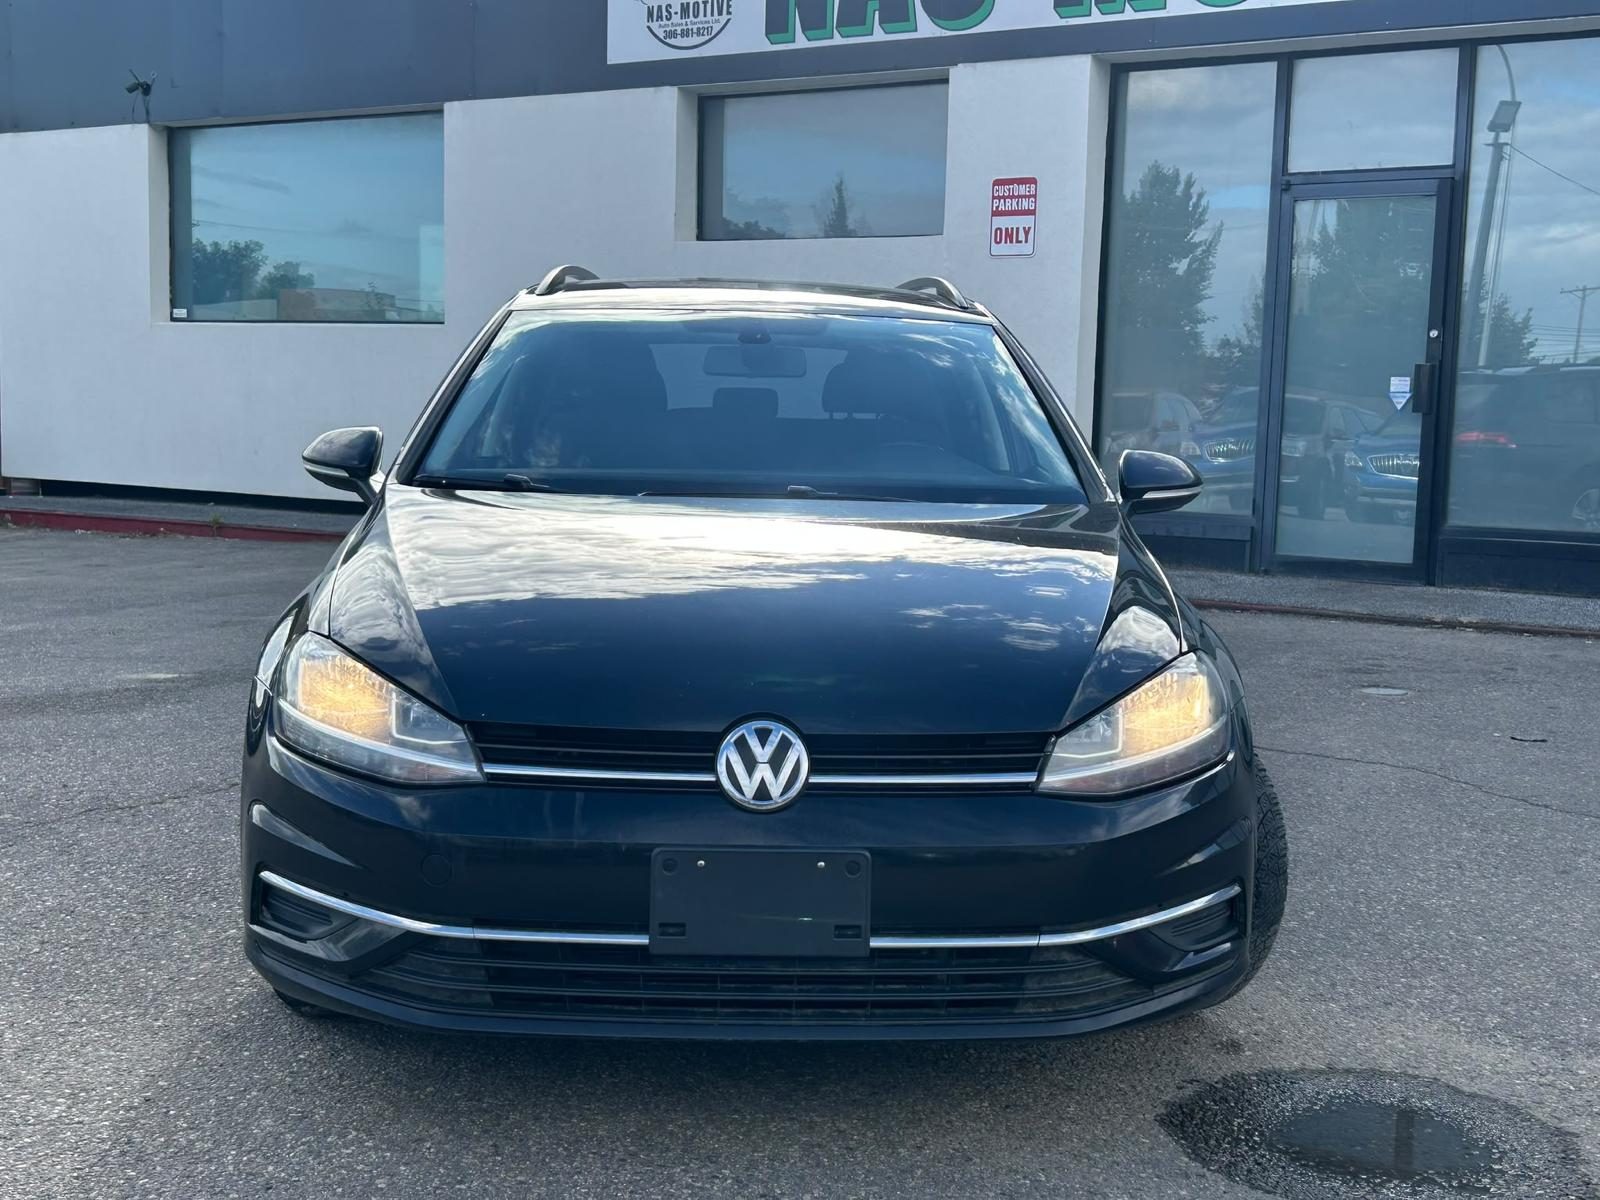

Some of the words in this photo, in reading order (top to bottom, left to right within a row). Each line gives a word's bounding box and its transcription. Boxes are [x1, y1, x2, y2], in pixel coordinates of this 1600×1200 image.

[646, 0, 732, 23] NAS-MOTIVE
[663, 26, 714, 40] 306-881-8217
[993, 184, 1036, 197] CUSTOMER
[992, 198, 1035, 211] PARKING
[993, 226, 1031, 245] ONLY
[717, 720, 809, 810] VW
